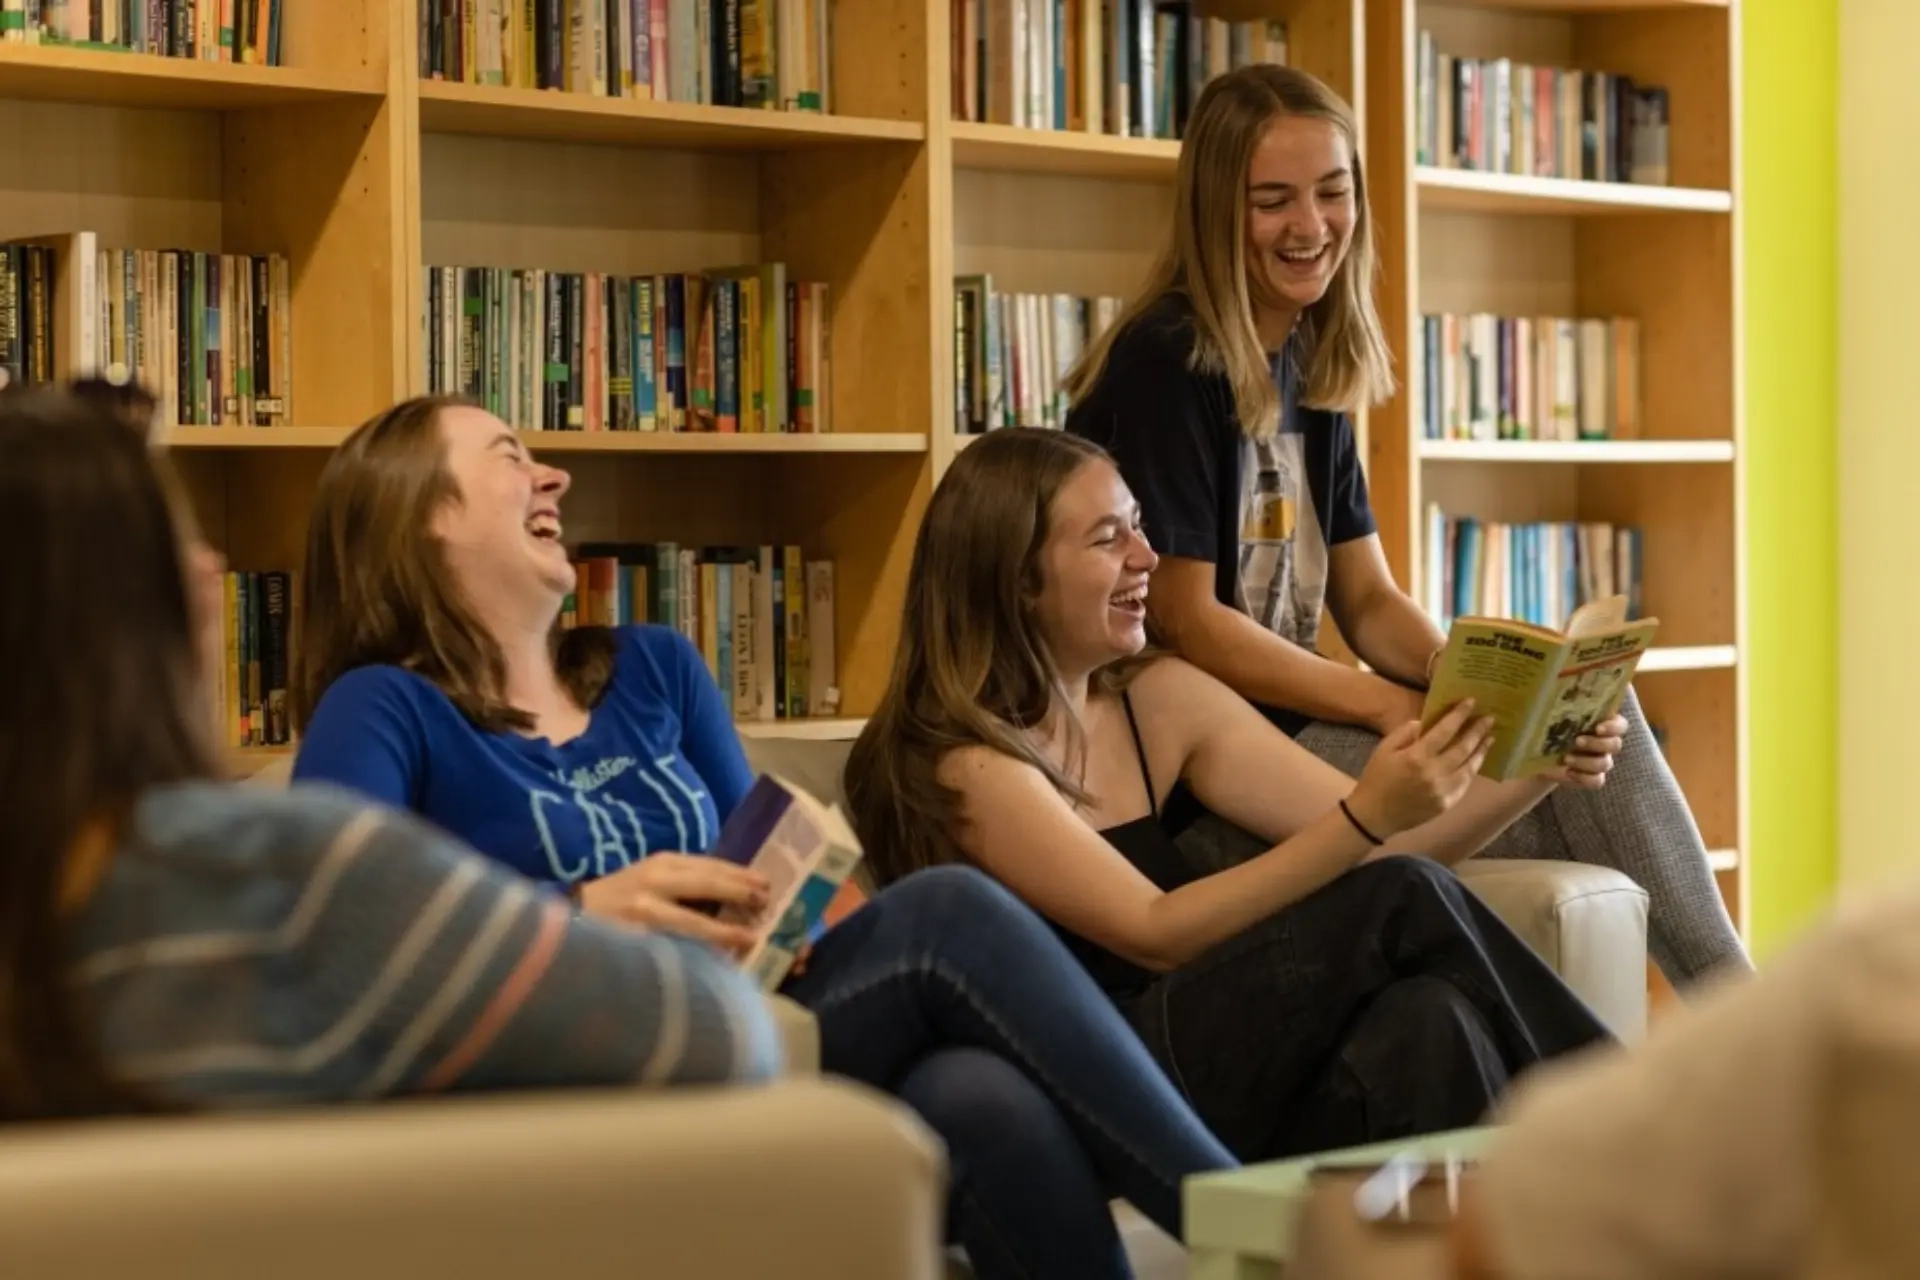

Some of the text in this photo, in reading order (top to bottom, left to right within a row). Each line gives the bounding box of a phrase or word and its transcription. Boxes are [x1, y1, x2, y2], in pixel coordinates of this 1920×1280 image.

[1493, 631, 1524, 645] THE
[1601, 633, 1626, 646] THE
[1465, 636, 1546, 661] ZOO GANG
